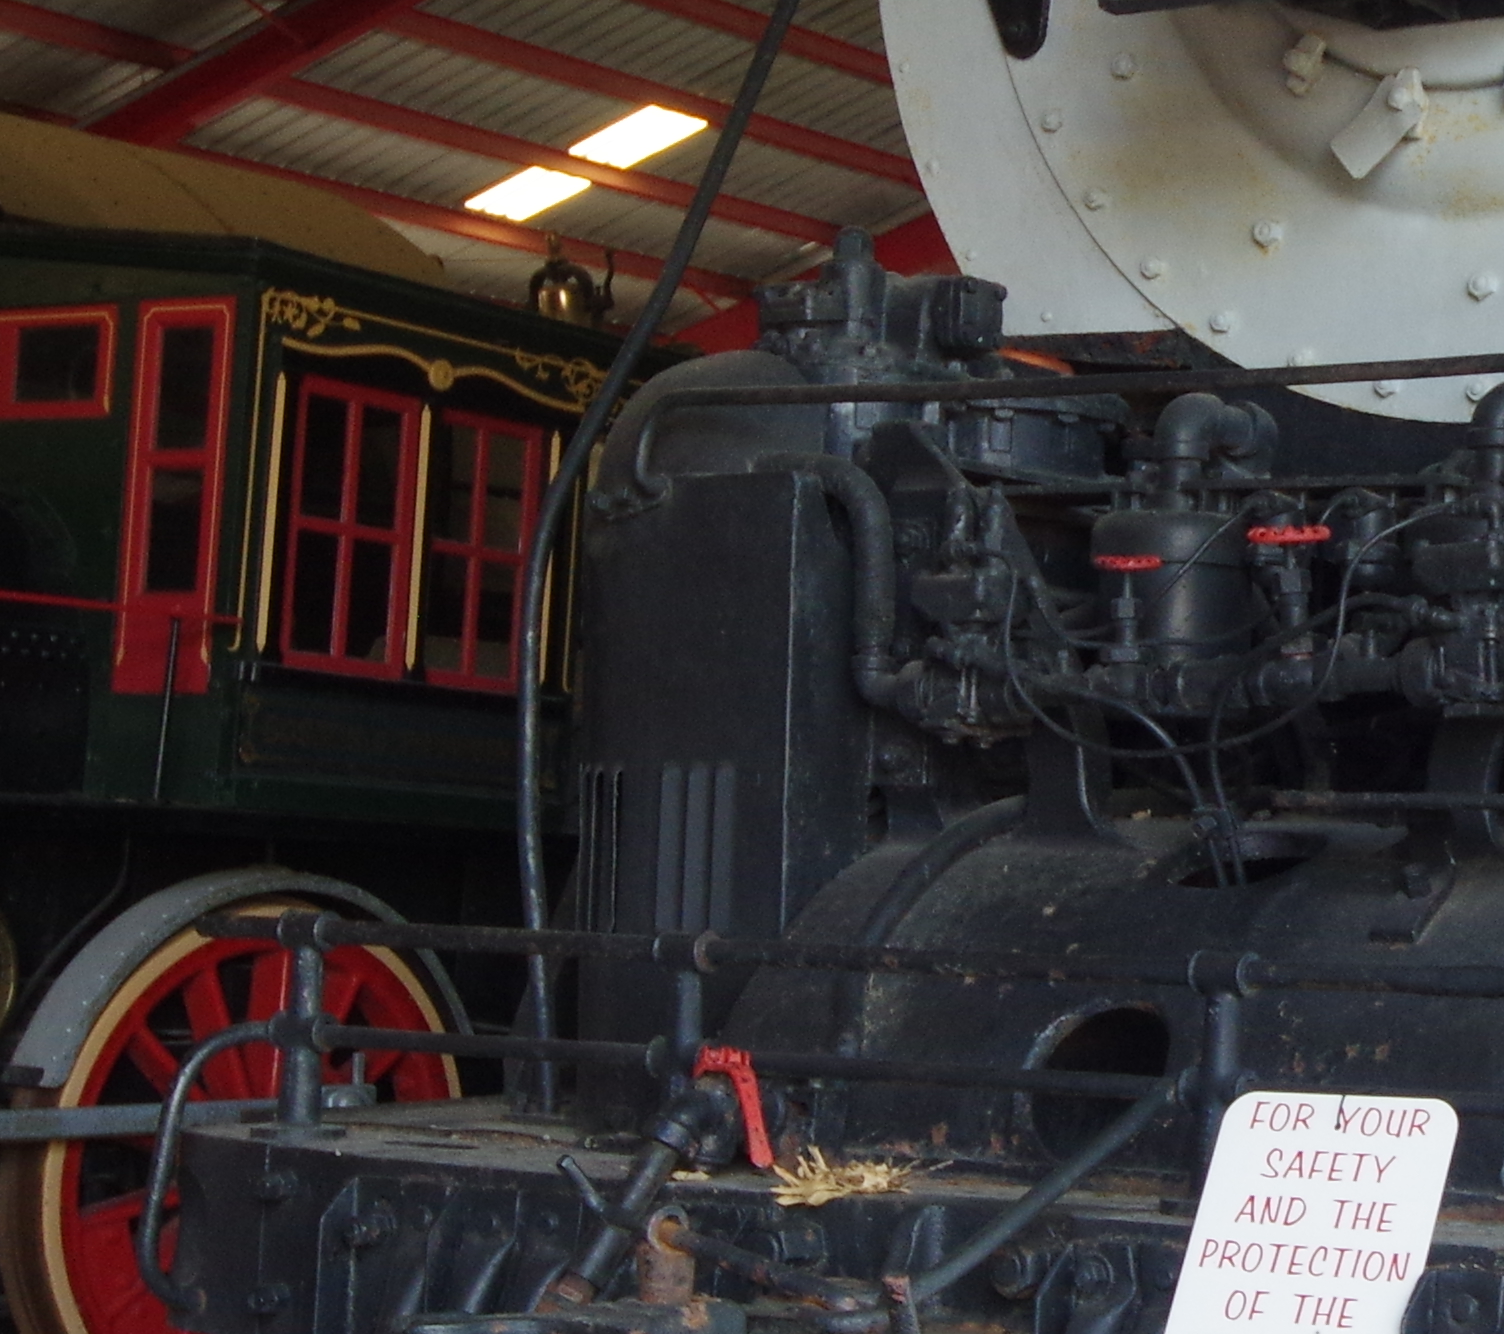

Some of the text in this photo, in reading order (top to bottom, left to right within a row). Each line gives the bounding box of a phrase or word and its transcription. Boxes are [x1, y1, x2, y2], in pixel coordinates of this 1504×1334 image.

[1251, 1101, 1430, 1137] FOR YOUR
[1260, 1148, 1396, 1183] SAFETY
[1235, 1195, 1397, 1232] AND THE
[1199, 1239, 1411, 1282] PROTECTION
[1225, 1290, 1358, 1328] OF THE
